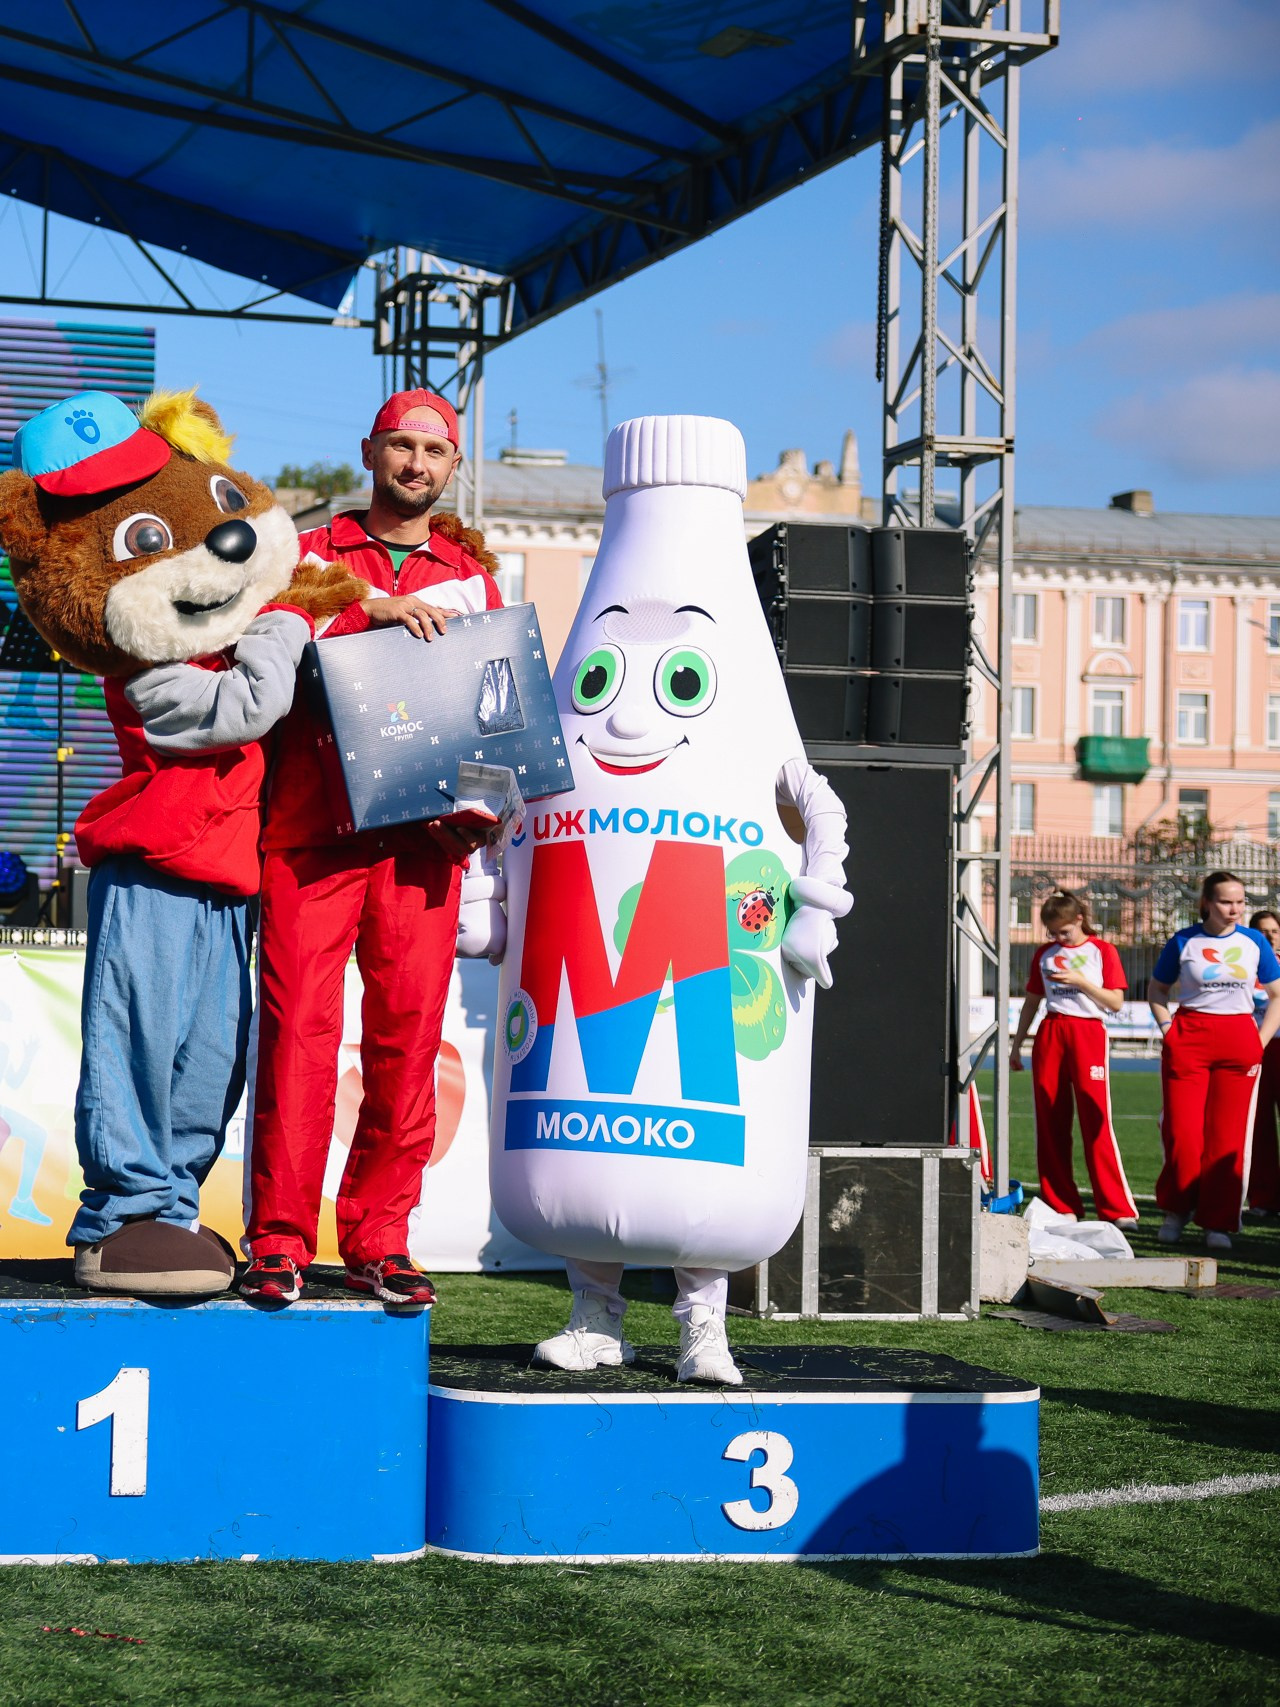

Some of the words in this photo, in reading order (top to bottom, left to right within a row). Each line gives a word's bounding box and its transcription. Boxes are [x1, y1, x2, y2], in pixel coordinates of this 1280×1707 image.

[380, 720, 424, 738] КОМОС
[394, 733, 414, 742] ГРУПП
[536, 1111, 696, 1150] МОЛОКО
[78, 1368, 149, 1495] 1
[724, 1431, 798, 1530] 3
